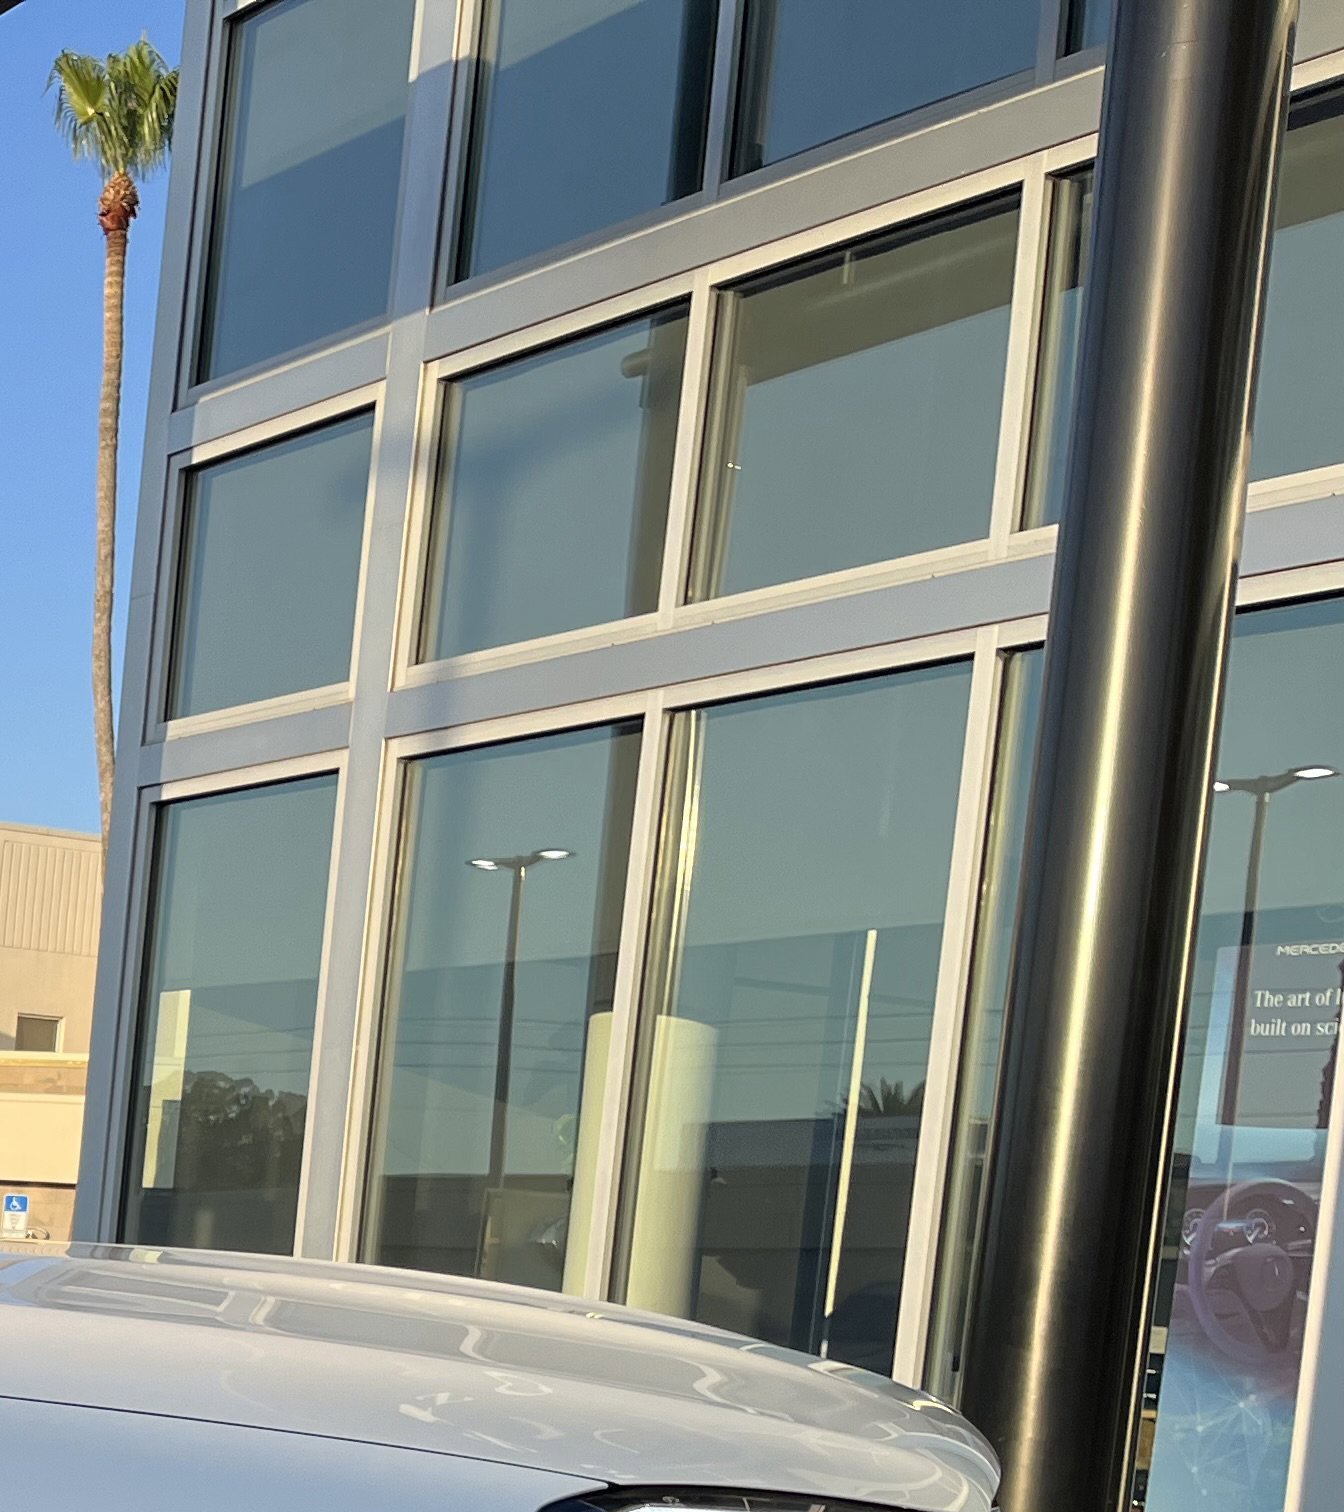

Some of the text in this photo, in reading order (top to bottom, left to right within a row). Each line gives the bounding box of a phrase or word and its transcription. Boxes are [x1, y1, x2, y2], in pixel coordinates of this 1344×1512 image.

[1254, 989, 1284, 1008] The
[1287, 990, 1311, 1007] art
[1315, 987, 1335, 1006] of
[1250, 1017, 1339, 1036] built on sci
